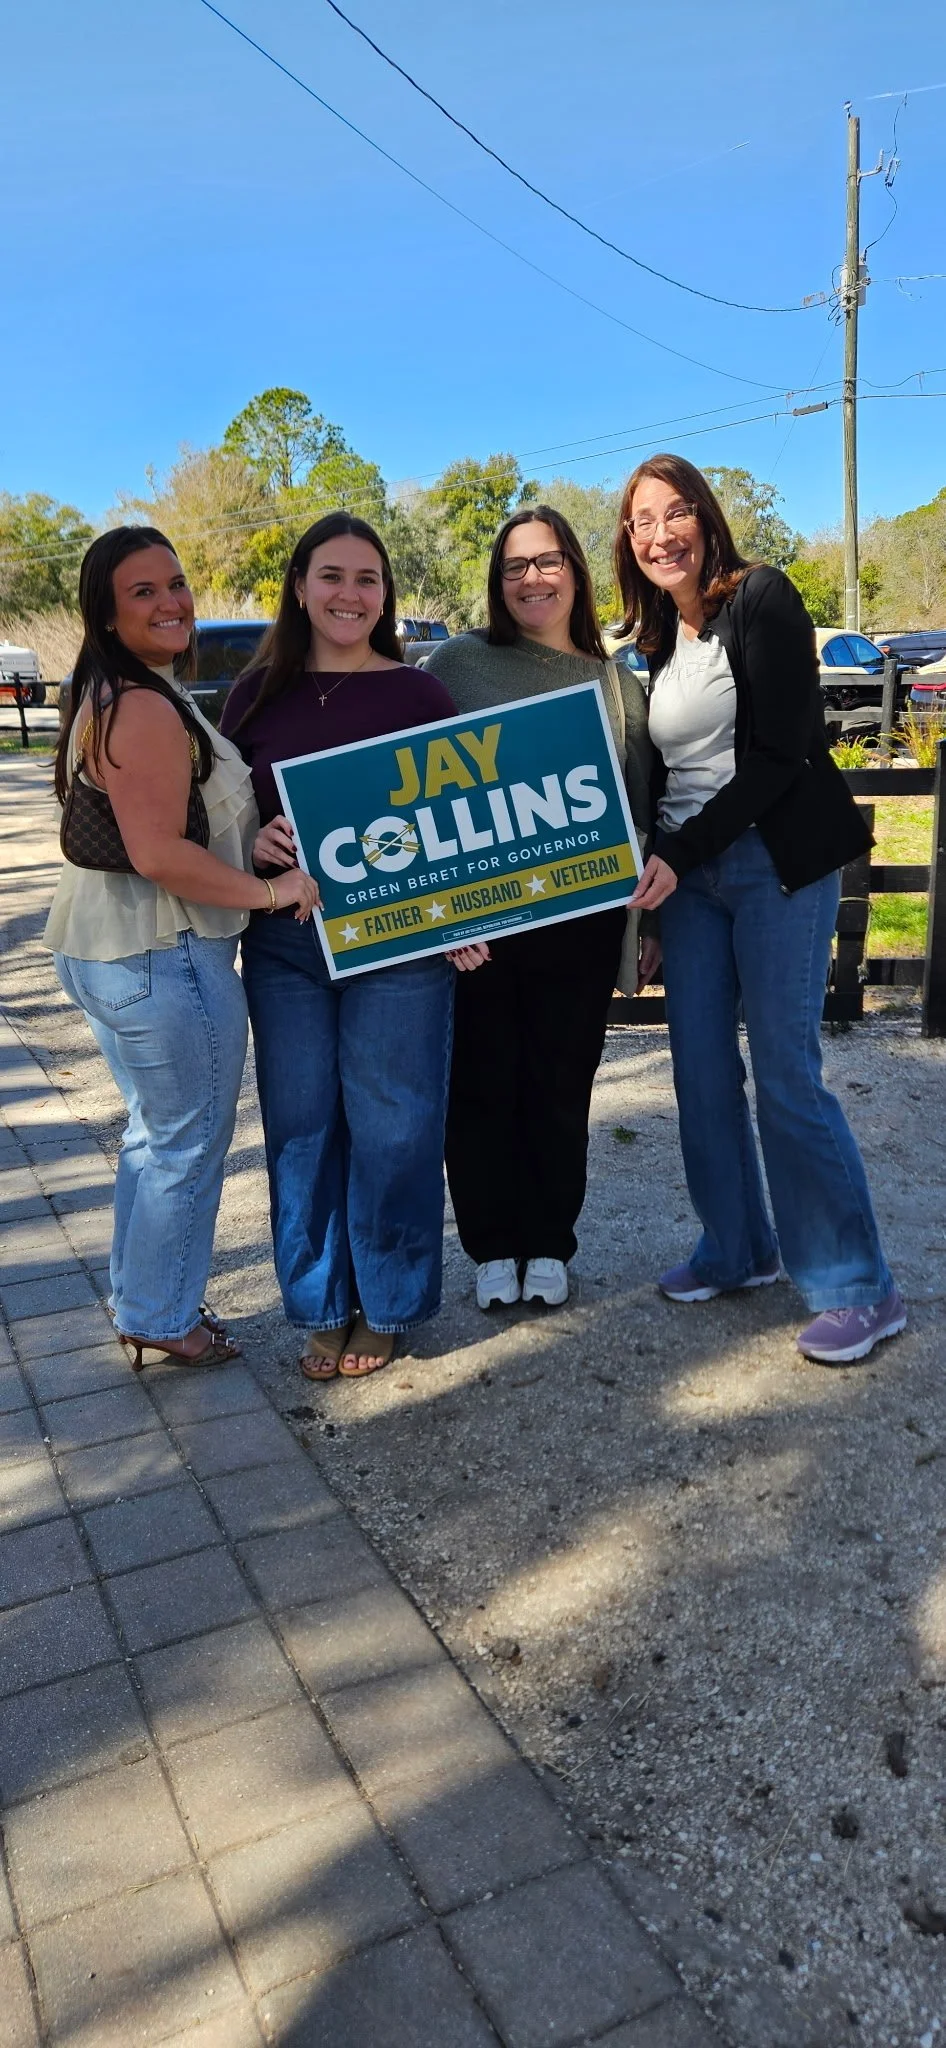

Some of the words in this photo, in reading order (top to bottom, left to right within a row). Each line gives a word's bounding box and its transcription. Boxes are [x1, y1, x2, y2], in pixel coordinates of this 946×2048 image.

[390, 723, 502, 806] JAY
[318, 765, 608, 884] COLLINS
[345, 882, 401, 905] GREEN
[408, 866, 459, 890] BERET
[467, 856, 500, 874] FOR
[508, 830, 600, 863] GOVERNOR
[363, 905, 424, 937] FATHER
[450, 880, 523, 915] HUSBAND
[550, 854, 620, 889] VETERAN
